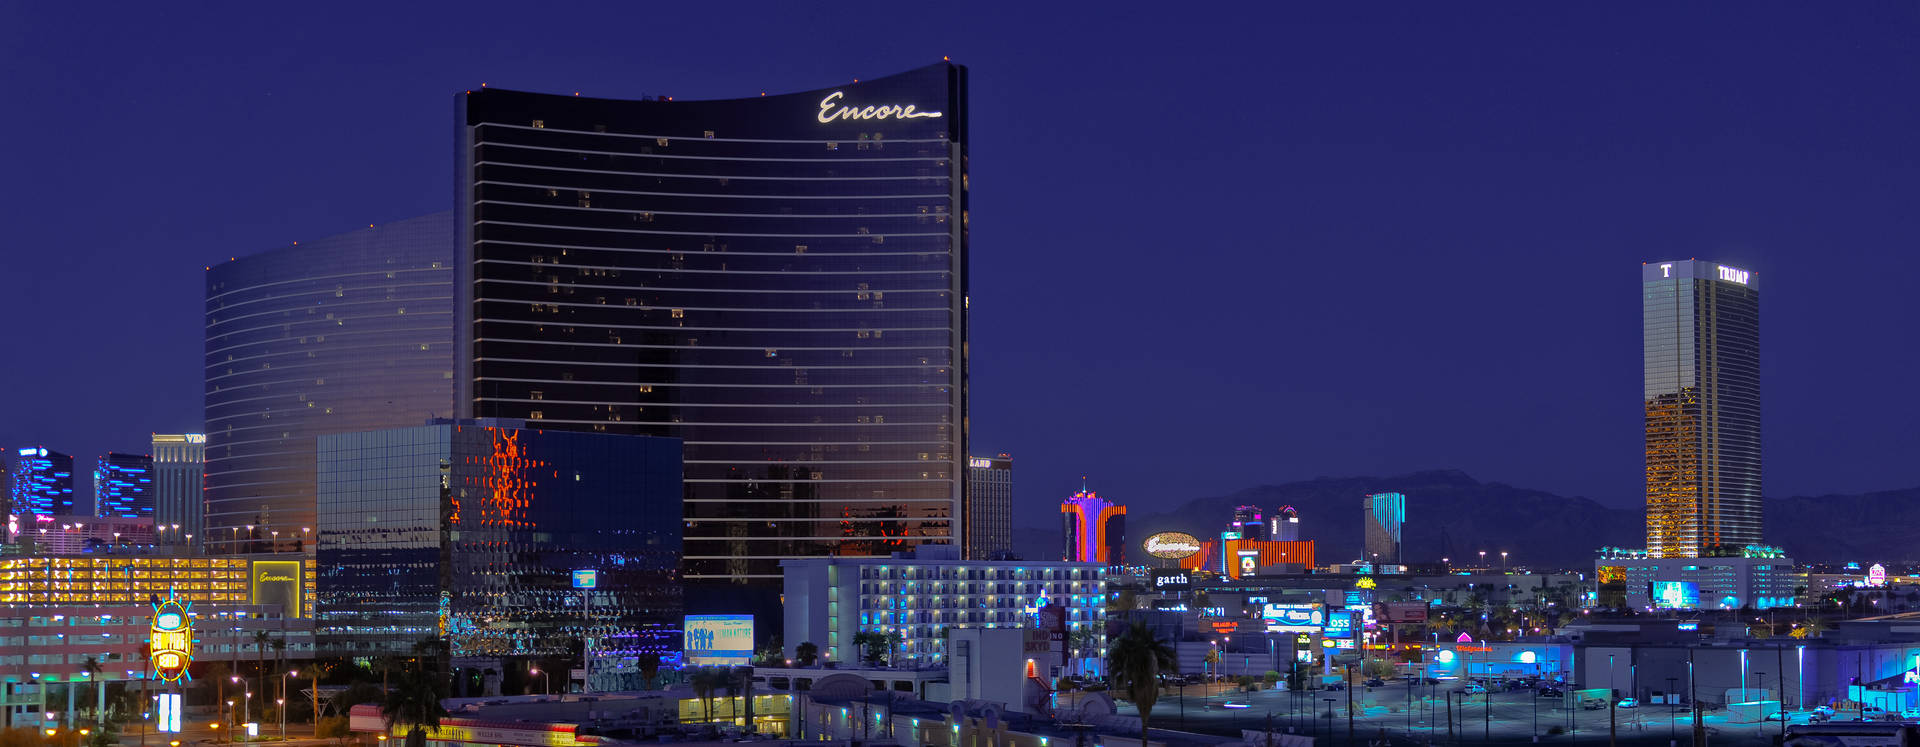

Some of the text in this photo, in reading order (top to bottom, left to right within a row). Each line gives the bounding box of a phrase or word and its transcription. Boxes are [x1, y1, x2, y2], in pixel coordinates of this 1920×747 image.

[818, 91, 942, 123] Encore
[1661, 264, 1672, 277] T
[1718, 265, 1750, 285] TRUMP
[969, 459, 991, 468] LAND
[260, 571, 296, 582] Encore
[1156, 573, 1188, 586] garth
